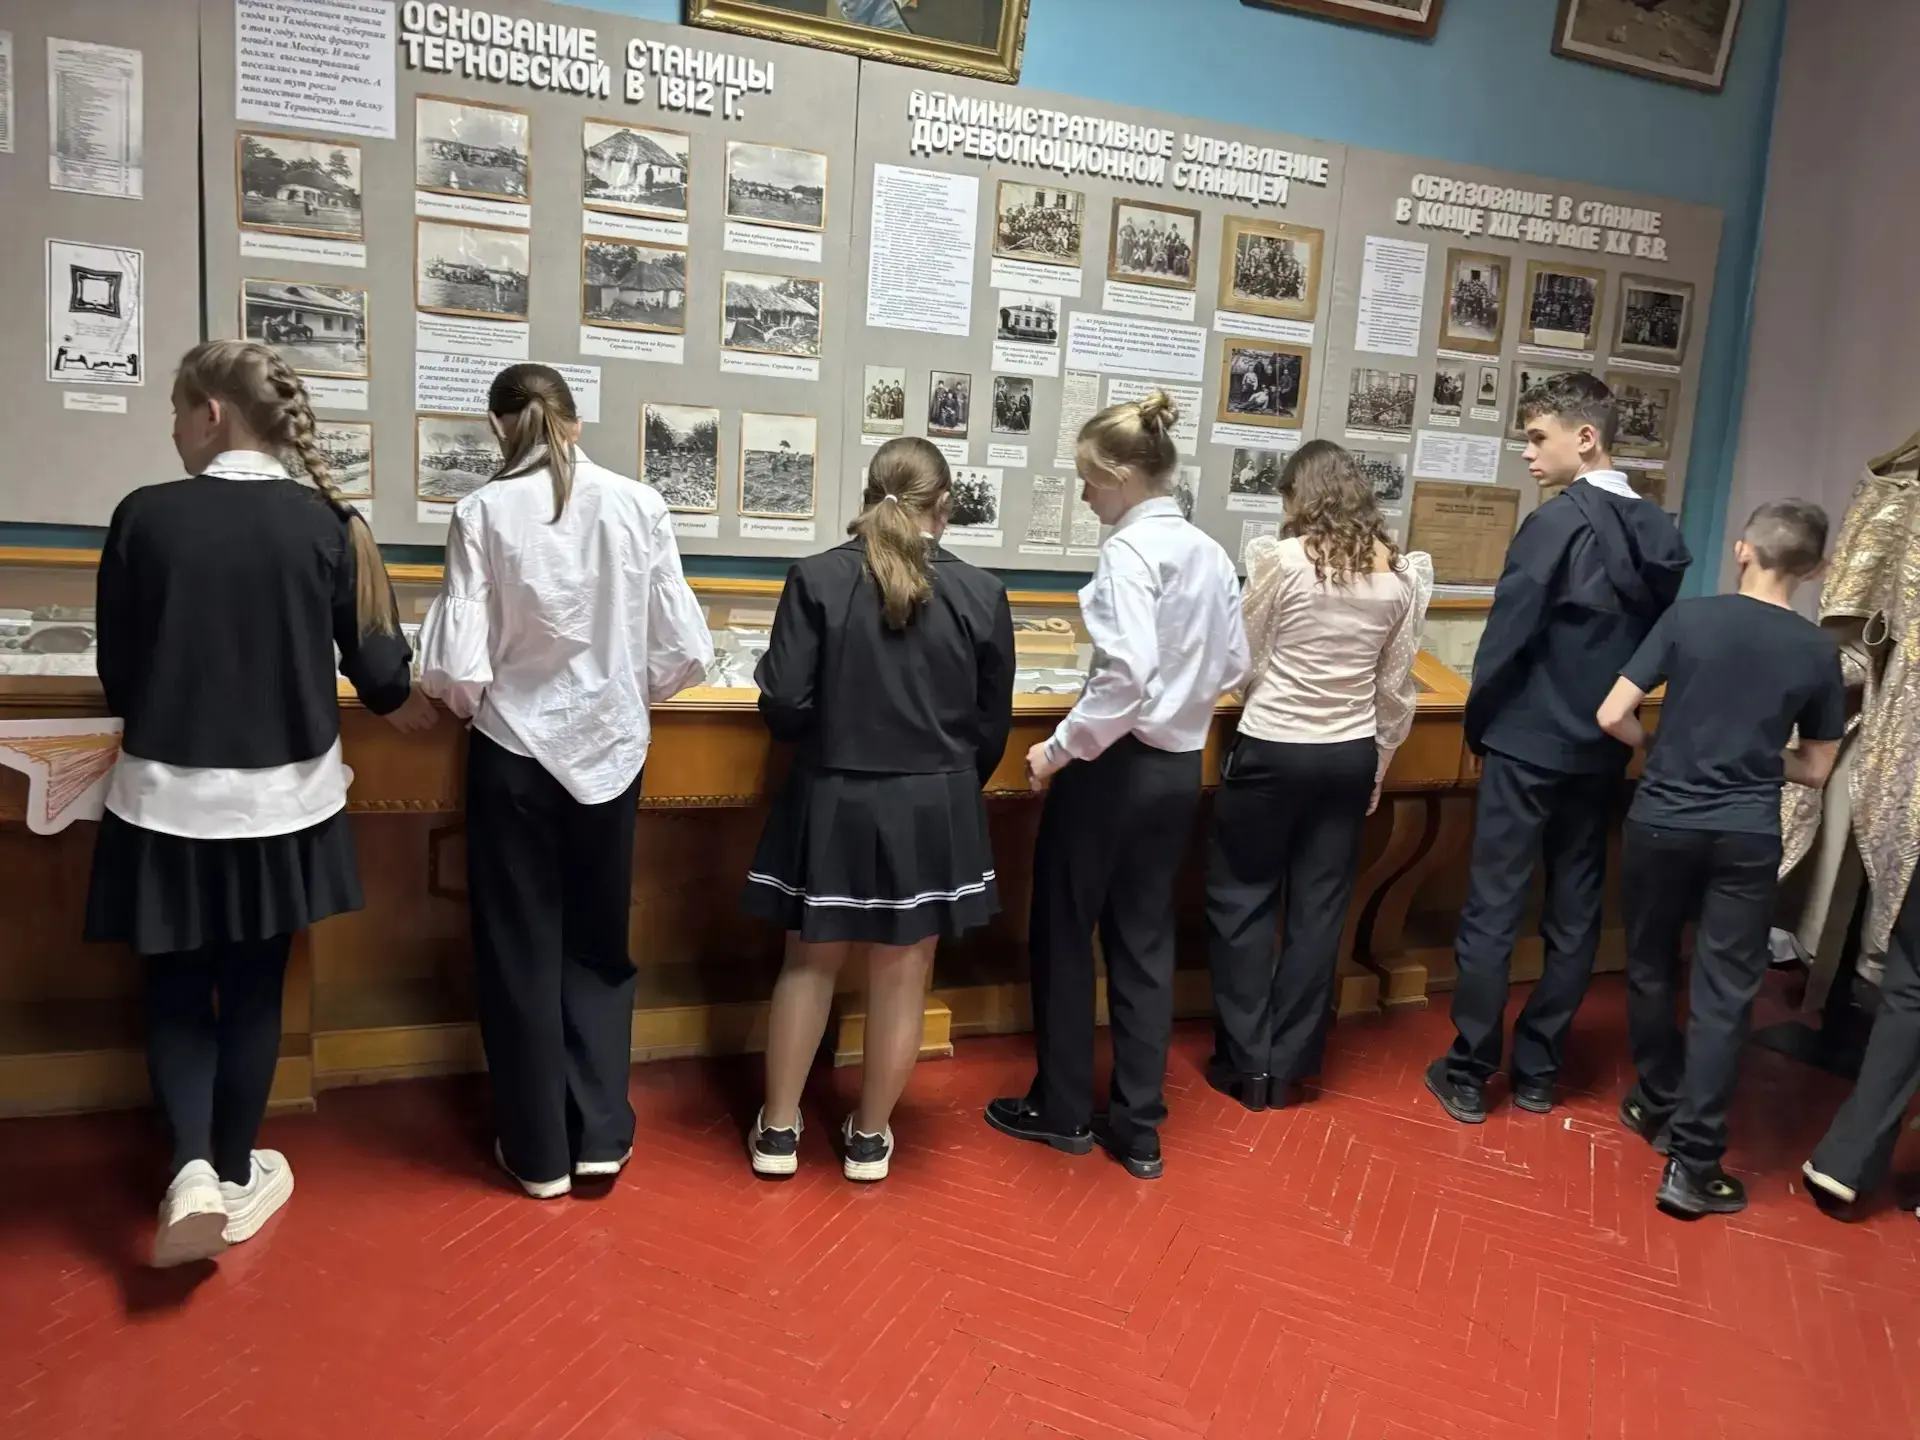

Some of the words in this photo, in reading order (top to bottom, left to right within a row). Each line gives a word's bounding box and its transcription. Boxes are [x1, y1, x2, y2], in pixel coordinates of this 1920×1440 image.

[276, 4, 341, 20] переселенцев
[250, 25, 271, 34] том
[300, 32, 326, 42] когда
[283, 13, 340, 32] Тамбовской
[342, 25, 386, 39] губернии
[276, 41, 288, 49] на
[402, 1, 597, 61] ОСНОВАНИЕ
[626, 38, 775, 92] СТАНИЦЫ
[241, 60, 298, 75] поселились
[300, 68, 312, 77] на
[401, 32, 611, 97] ТЕРНОВСКОЙ
[624, 69, 646, 101] В
[659, 76, 715, 113] 1812
[722, 86, 746, 118] Г.
[242, 72, 262, 81] так
[264, 75, 281, 84] как
[283, 78, 307, 88] тут
[240, 84, 301, 98] множество
[241, 97, 281, 109] назвали
[908, 89, 1175, 157] АДМИНИСТРАТИВНОЕ
[1181, 132, 1329, 186] УПРАВЛЕНИЕ
[910, 119, 1166, 184] ДОРЕВОЛЮЦИОННОЙ
[1171, 160, 1290, 206] СТАНИЦЕЙ
[1411, 173, 1554, 217] ОБРАЗОВАНИЕ
[1557, 195, 1574, 221] В
[1578, 200, 1662, 235] СТАНИЦЕ
[1395, 197, 1412, 222] В
[1416, 200, 1484, 237] КОНЦЕ
[1635, 235, 1668, 261] ВВ.
[419, 363, 460, 373] повеления
[443, 355, 450, 363] В
[451, 355, 469, 365] 1848
[470, 358, 487, 367] году
[424, 374, 470, 384] жителями
